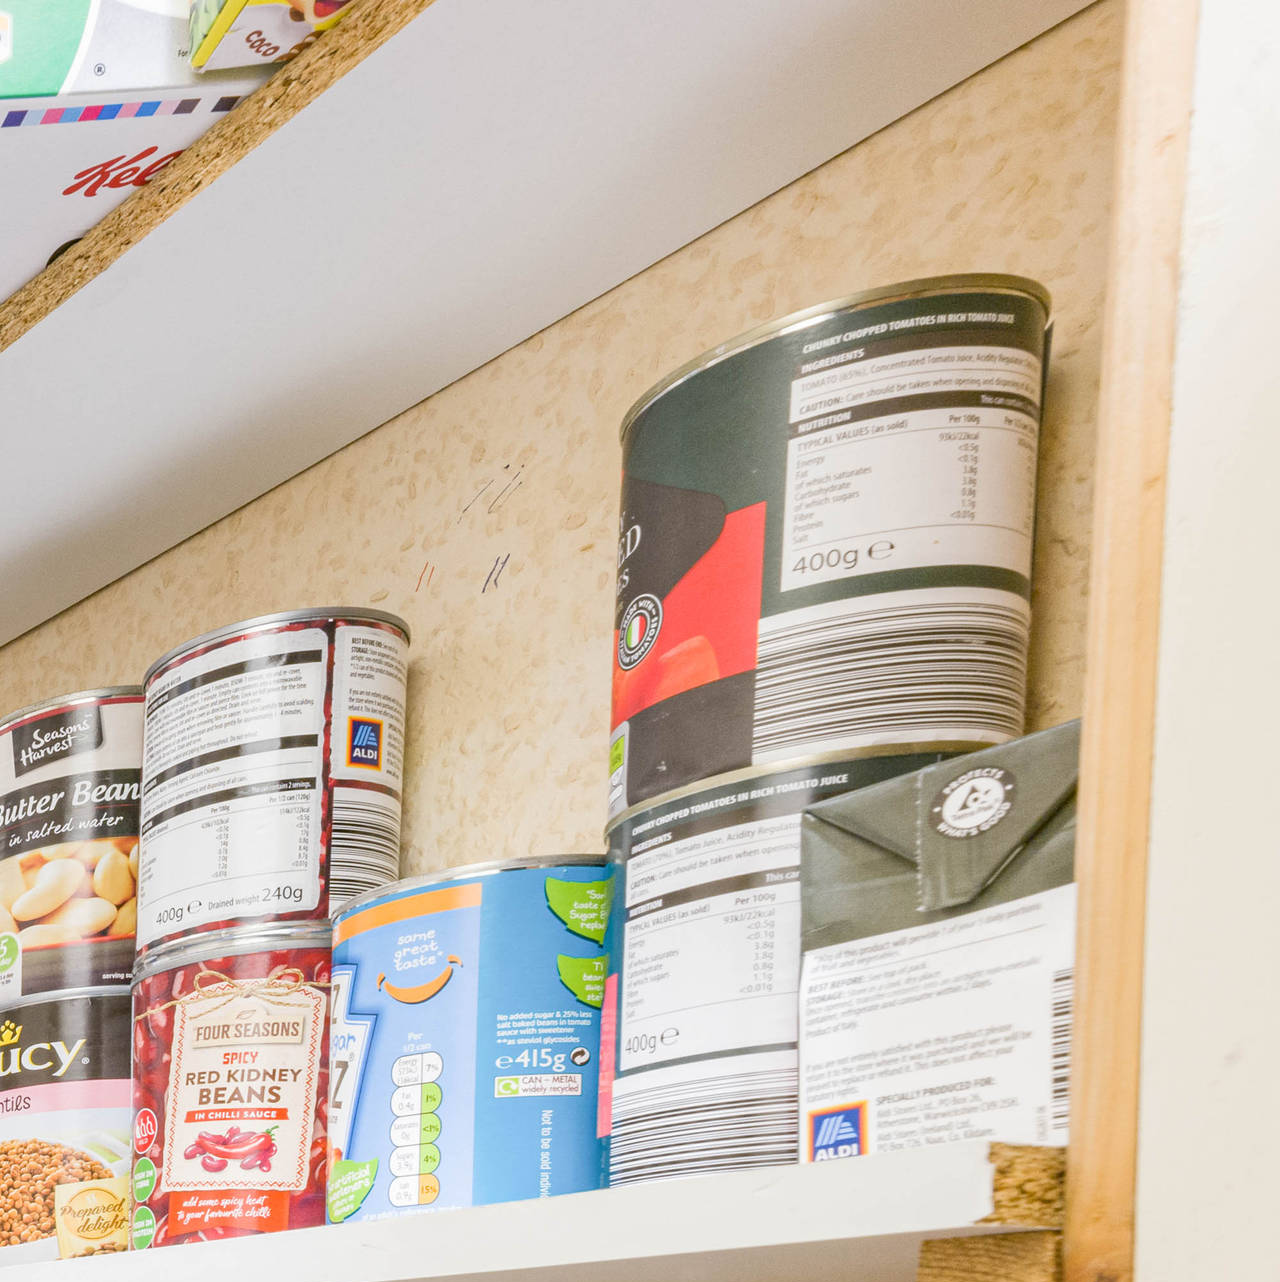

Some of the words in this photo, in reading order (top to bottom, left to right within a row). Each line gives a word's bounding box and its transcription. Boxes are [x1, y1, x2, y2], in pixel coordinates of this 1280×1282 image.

[802, 333, 841, 354] CHUNKY
[842, 324, 888, 342] CHOPPED
[889, 315, 936, 331] TOMATOES
[937, 314, 947, 323] IN
[947, 313, 966, 322] RICH
[967, 313, 998, 323] TOMATO
[800, 348, 865, 374] INGREDIENTS
[792, 548, 859, 575] 400g
[32, 719, 91, 751] Seasons
[19, 734, 74, 768] Harvest
[352, 747, 378, 761] ALDI
[942, 768, 1005, 797] PROTECTS
[690, 793, 737, 816] TOMATOES
[738, 791, 748, 802] IN
[749, 786, 775, 800] RICH
[776, 778, 819, 794] TOMATO
[819, 772, 849, 786] JUICE
[8, 832, 23, 848] in
[25, 817, 73, 843] salted
[78, 813, 124, 830] water
[155, 906, 184, 925] 400g
[262, 885, 304, 903] 240g
[393, 940, 439, 962] great
[195, 1024, 232, 1042] FOUR
[233, 1021, 300, 1039] SEASONS
[624, 1031, 658, 1054] 400g
[222, 1052, 259, 1065] SPICY
[185, 1070, 221, 1086] RED
[226, 1068, 303, 1084] KIDNEY
[521, 1076, 543, 1084] CAN
[552, 1075, 578, 1083] METAL
[198, 1085, 282, 1106] BEANS
[549, 1085, 580, 1094] recycled
[195, 1112, 206, 1120] IN
[208, 1111, 240, 1120] CHILLI
[243, 1110, 277, 1119] SAUCE
[541, 1109, 553, 1127] Not
[541, 1128, 552, 1138] to
[541, 1140, 552, 1152] be
[814, 1142, 859, 1162] ALDI
[540, 1153, 551, 1171] sold
[59, 1197, 126, 1218] Prepared
[220, 1196, 244, 1209] spicy
[245, 1194, 267, 1206] heat
[244, 1205, 272, 1218] chilli
[76, 1215, 128, 1234] delight
